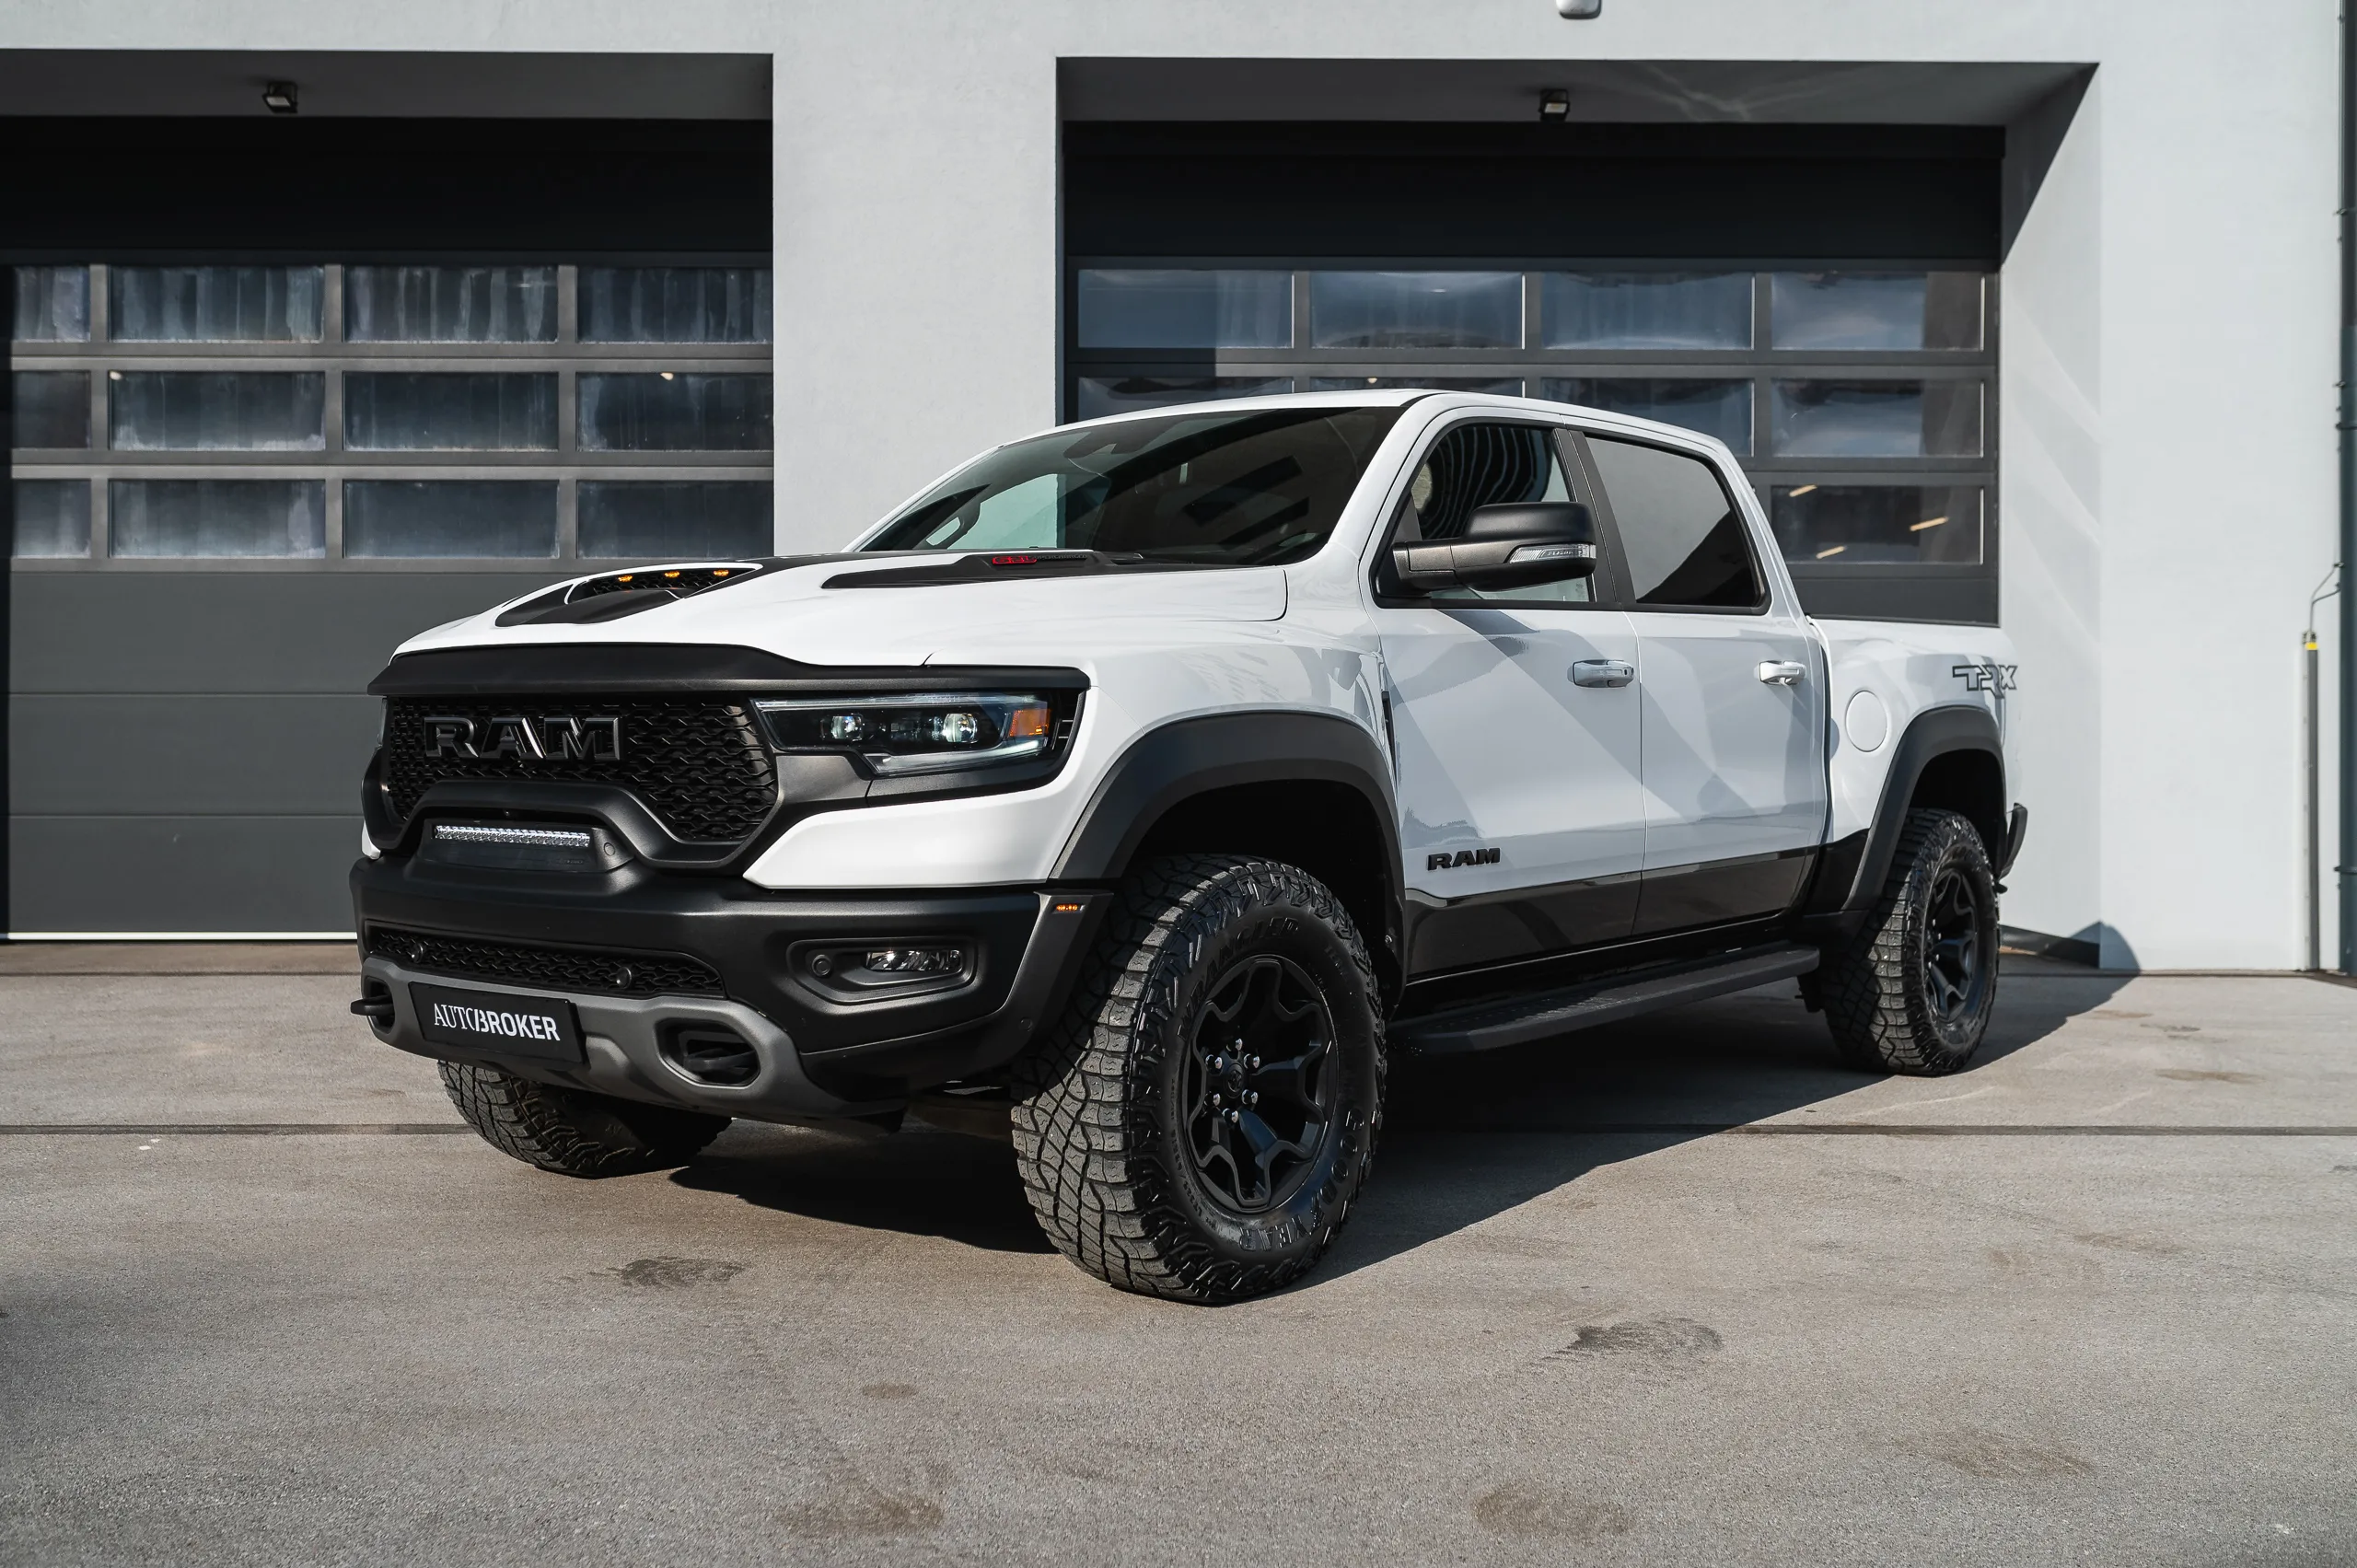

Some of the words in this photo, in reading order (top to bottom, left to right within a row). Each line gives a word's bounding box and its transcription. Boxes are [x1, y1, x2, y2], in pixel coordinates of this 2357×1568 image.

[1952, 664, 2018, 699] TRX
[424, 716, 621, 761] RAM
[1427, 847, 1501, 871] RAM
